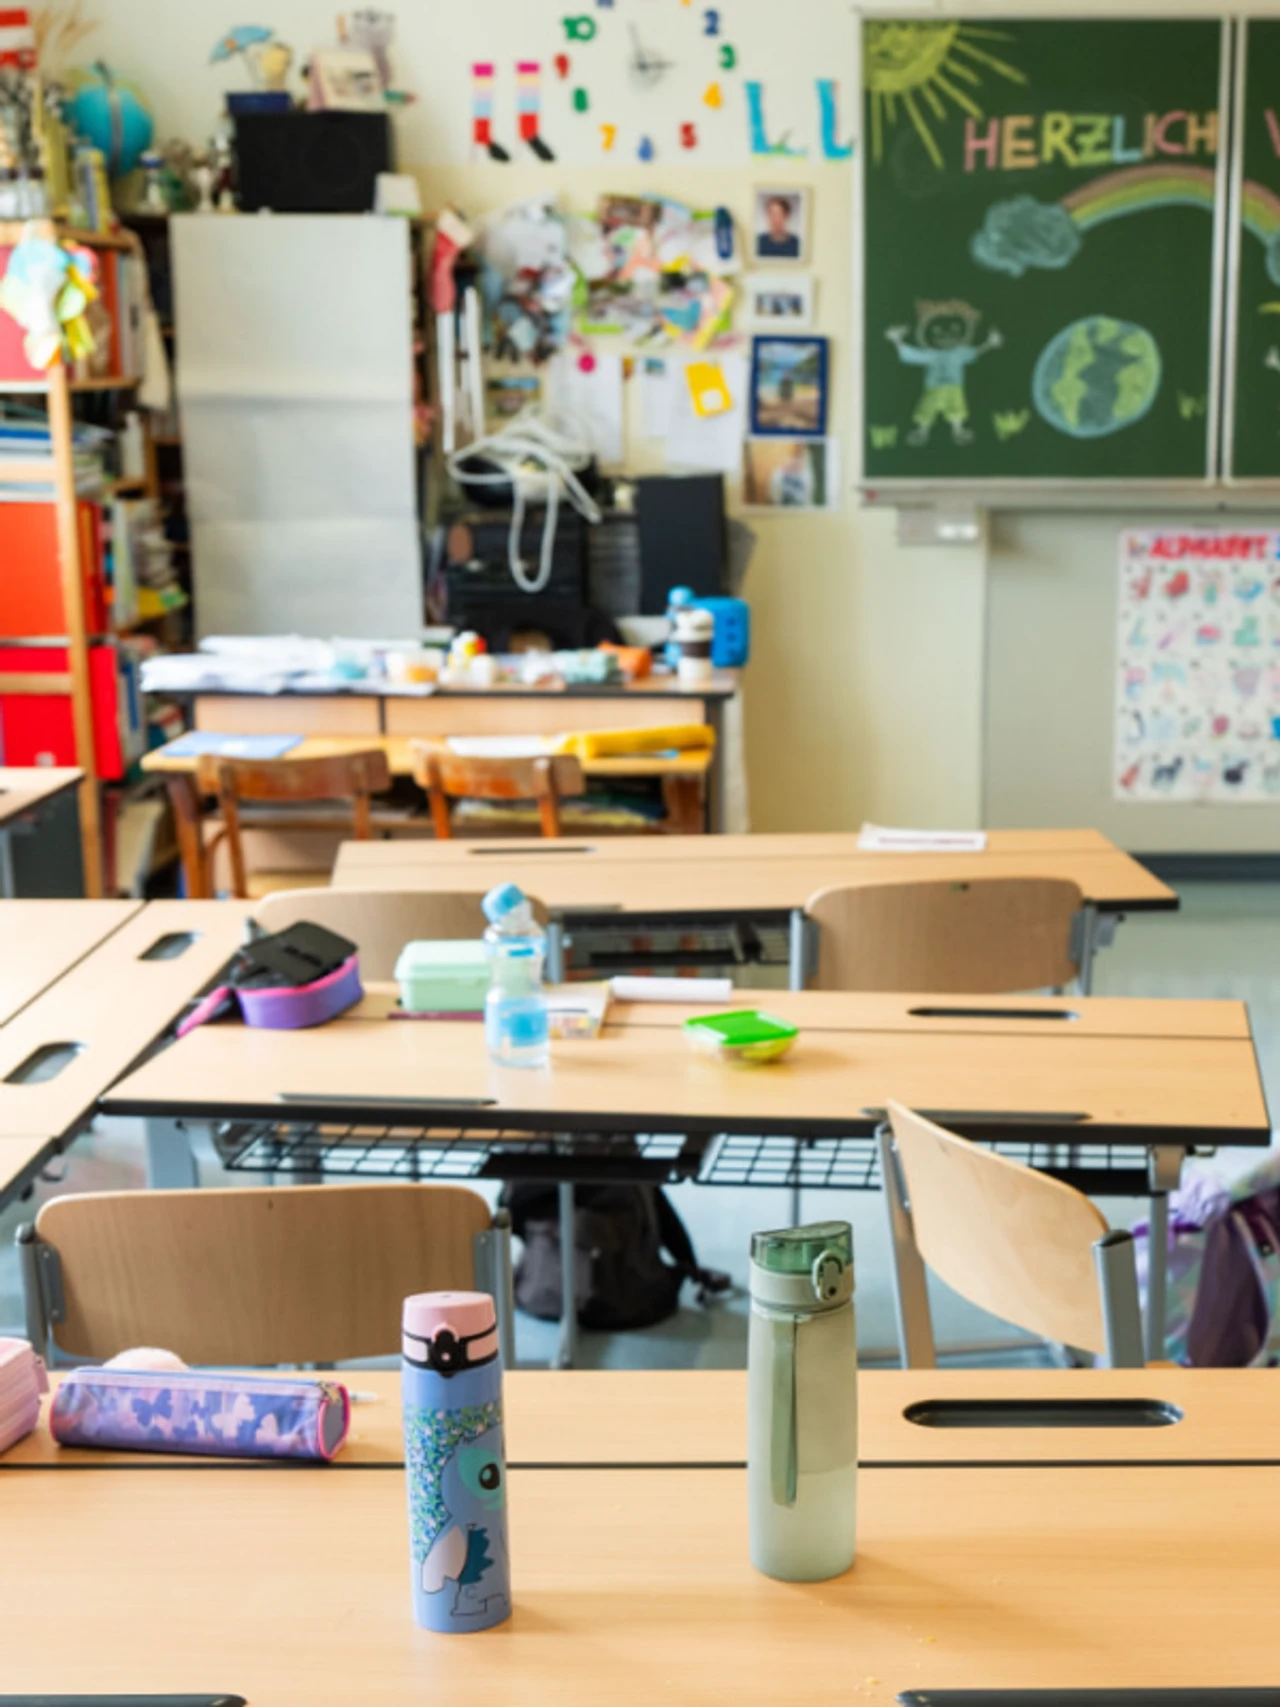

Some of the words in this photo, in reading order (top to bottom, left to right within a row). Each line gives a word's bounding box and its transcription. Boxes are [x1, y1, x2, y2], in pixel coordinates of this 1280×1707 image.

[563, 16, 596, 41] 10
[704, 10, 719, 35] 2
[720, 45, 736, 70] 3
[601, 124, 616, 151] 7
[963, 110, 1219, 173] HERZLICH
